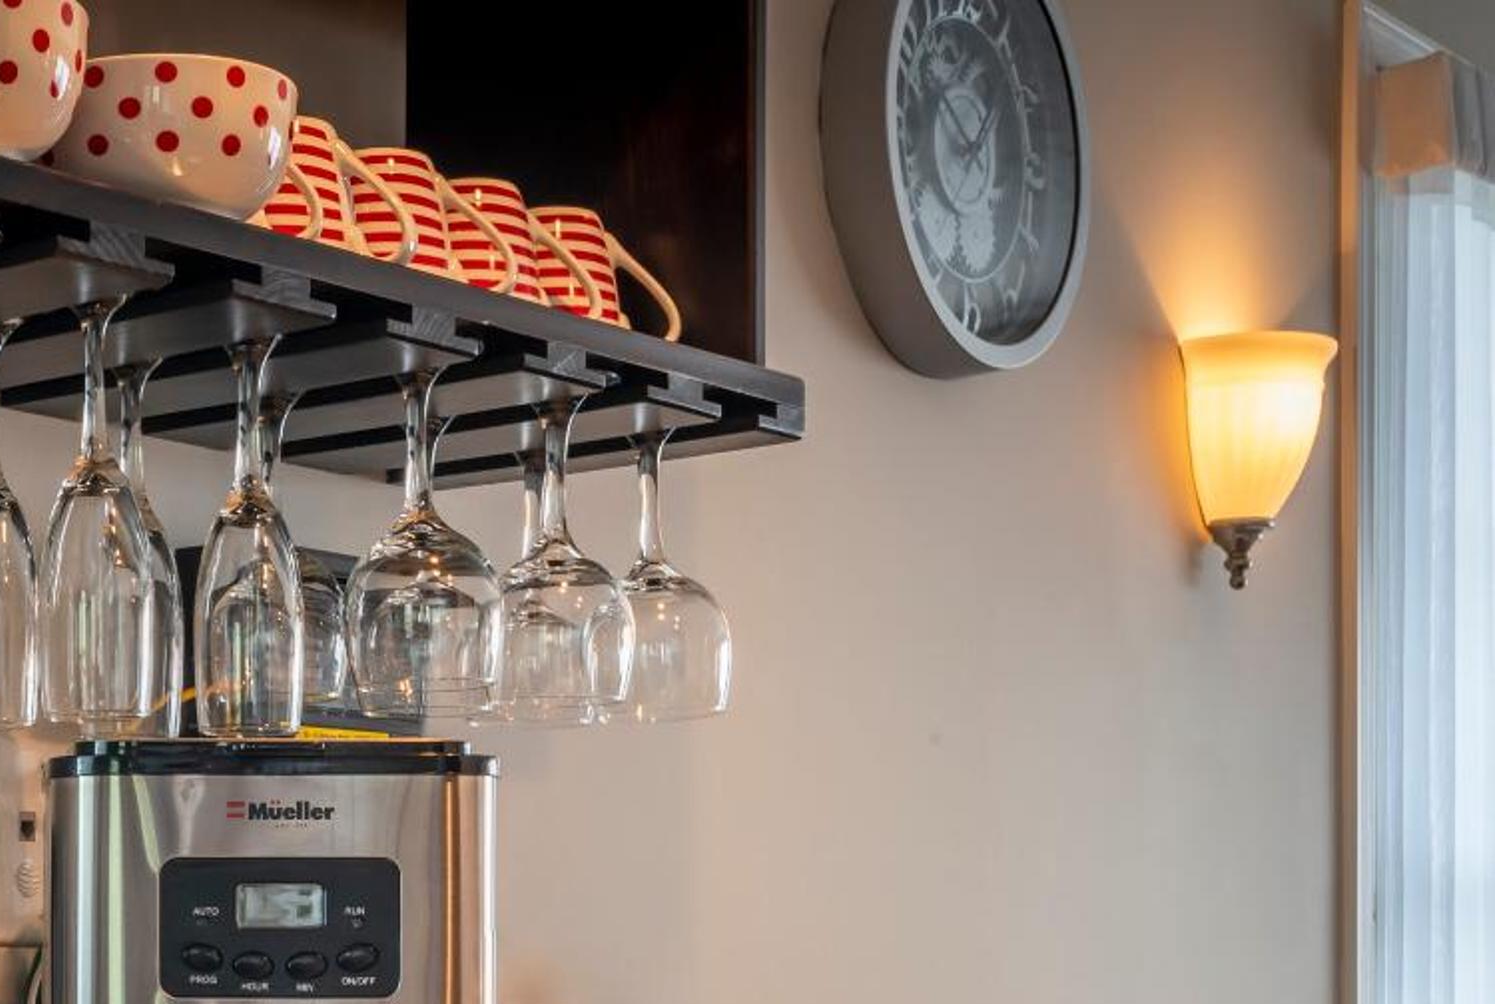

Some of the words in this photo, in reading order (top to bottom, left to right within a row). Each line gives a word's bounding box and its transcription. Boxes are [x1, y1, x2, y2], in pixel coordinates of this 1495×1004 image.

[248, 799, 335, 821] Müeller
[192, 905, 220, 917] AUTO
[343, 905, 366, 916] RUN
[189, 974, 218, 985] PROG
[340, 976, 377, 987] ON/OFF
[241, 982, 269, 992] HOUR
